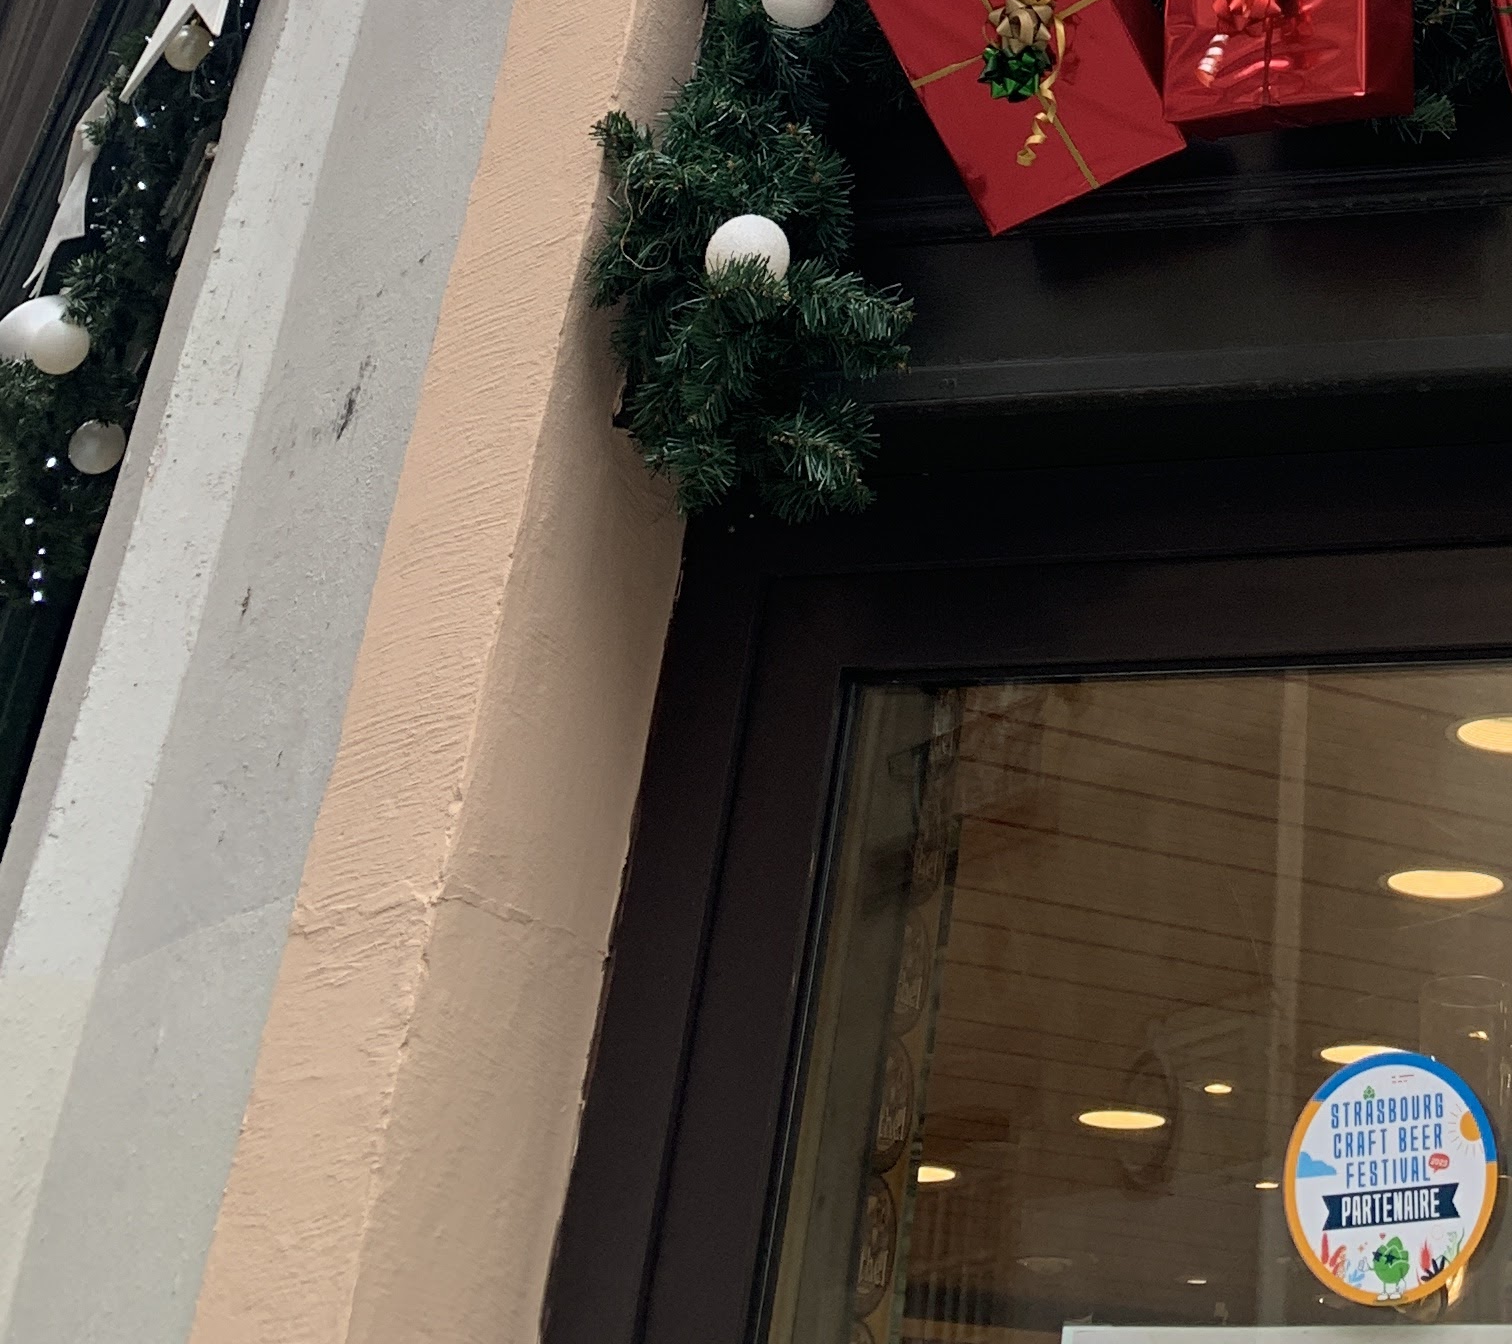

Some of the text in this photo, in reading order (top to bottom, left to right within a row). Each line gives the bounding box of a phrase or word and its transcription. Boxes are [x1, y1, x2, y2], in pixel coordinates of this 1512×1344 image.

[1331, 1092, 1444, 1129] STRASBOURG
[1333, 1123, 1443, 1159] CRAFT BEER
[1346, 1156, 1431, 1189] FESTIVAL
[1341, 1188, 1441, 1228] PARTENAIRE
